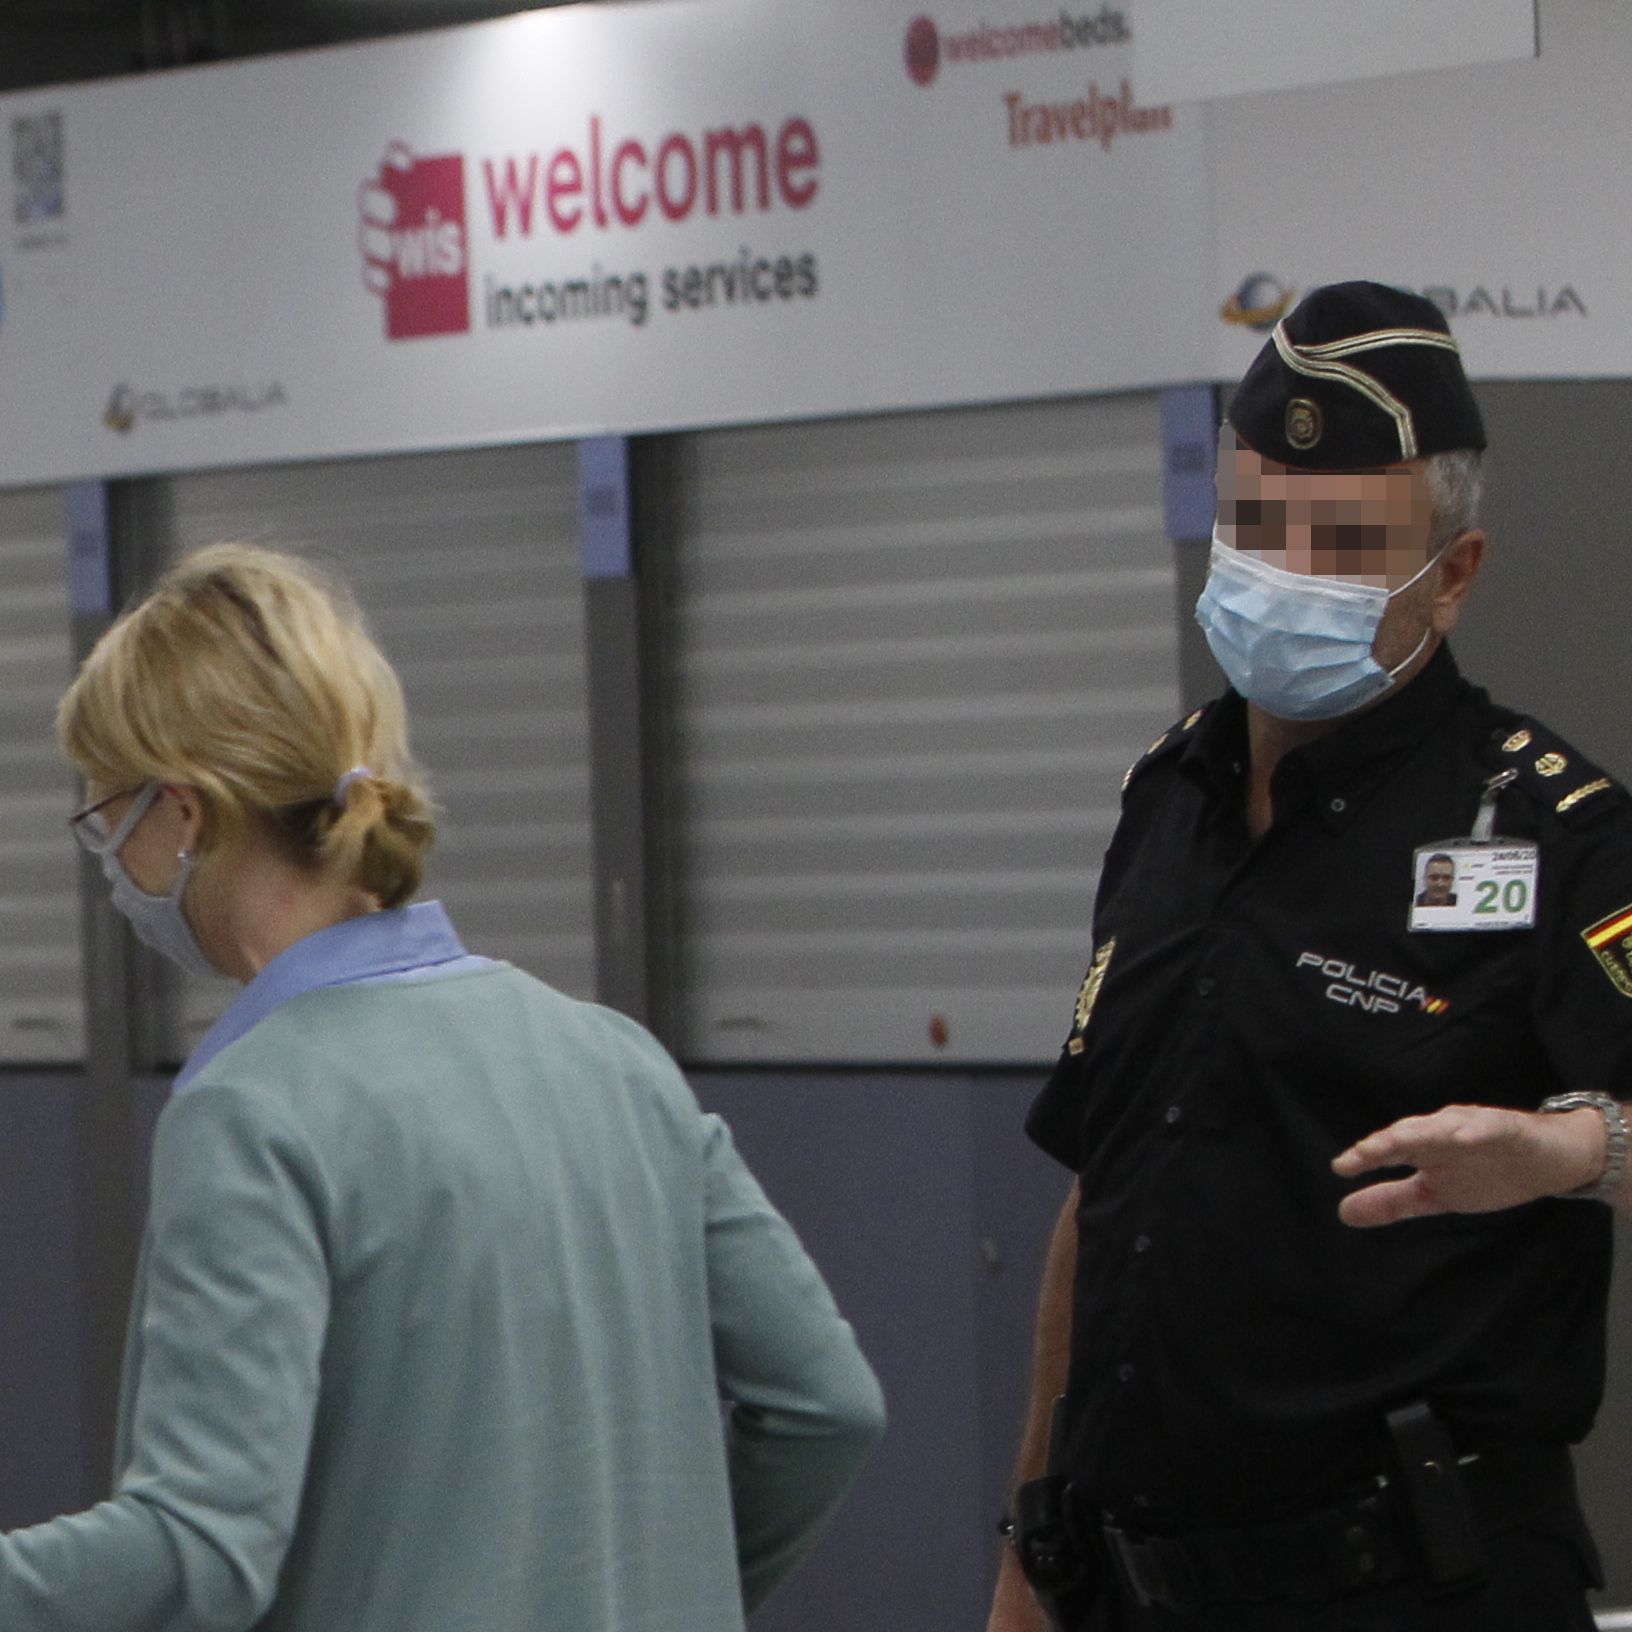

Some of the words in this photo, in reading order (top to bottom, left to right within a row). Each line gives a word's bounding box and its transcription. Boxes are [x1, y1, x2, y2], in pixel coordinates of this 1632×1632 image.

[482, 113, 818, 239] welcome
[485, 264, 647, 327] incoming
[663, 247, 818, 312] services
[1473, 879, 1528, 914] 20
[1295, 951, 1427, 1006] POLICIA
[1325, 983, 1400, 1014] CNP
